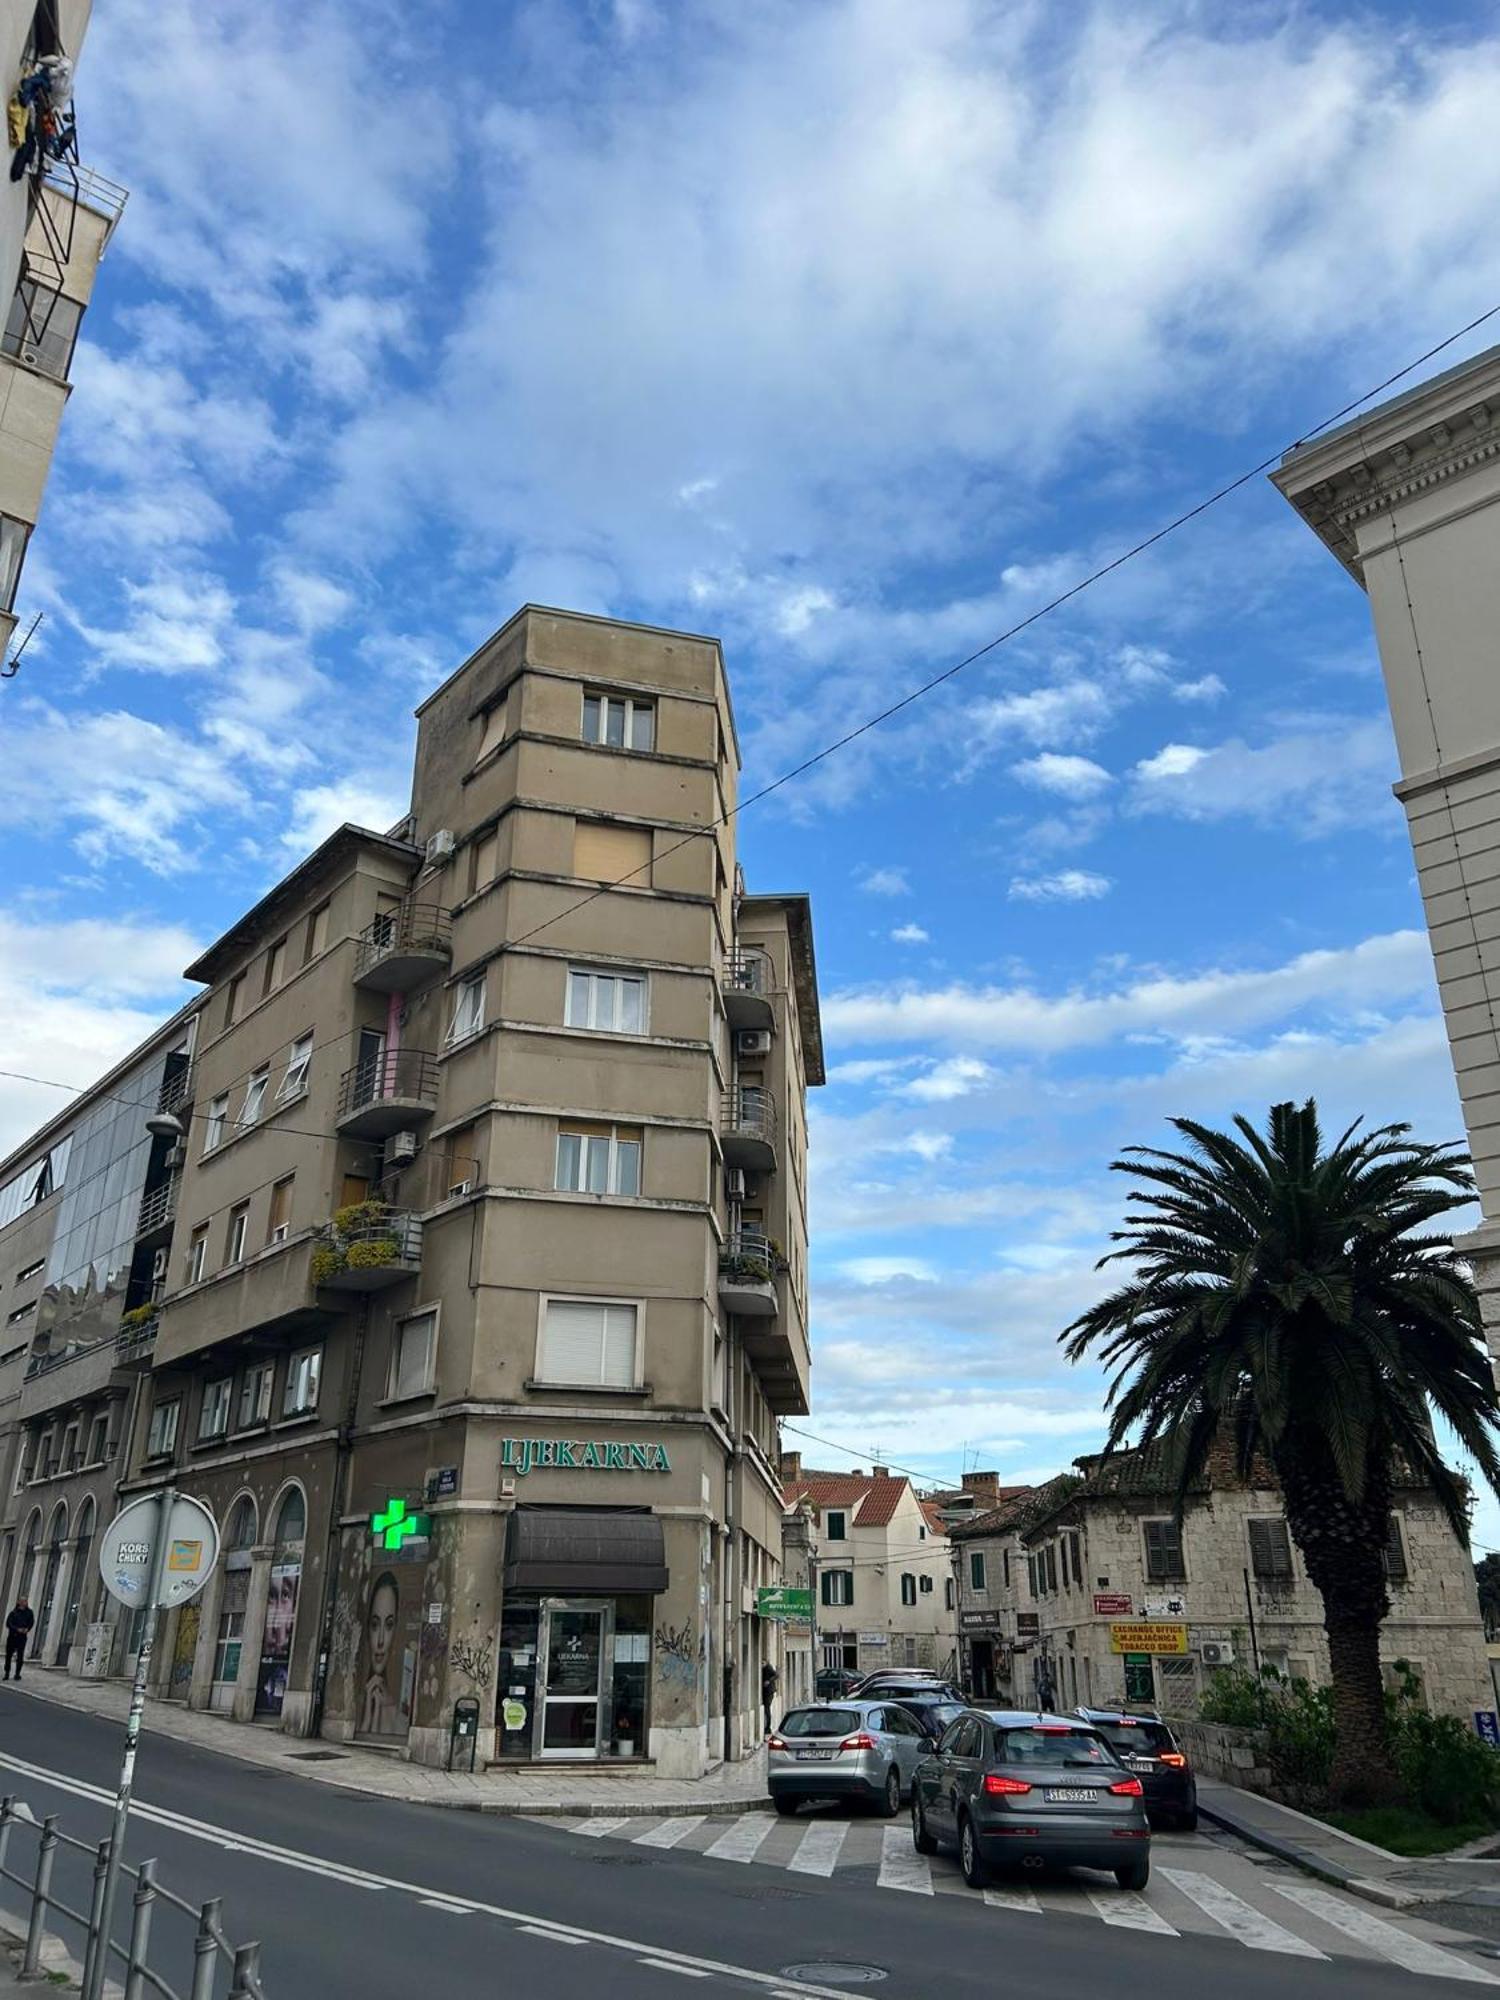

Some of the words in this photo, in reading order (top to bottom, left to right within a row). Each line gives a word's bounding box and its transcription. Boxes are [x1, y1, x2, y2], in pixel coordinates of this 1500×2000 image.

[501, 1438, 672, 1475] LJEKARNA
[119, 1543, 149, 1553] KORS
[1113, 1625, 1153, 1633] EXCHANGE
[1156, 1625, 1183, 1633] OFFICE
[1158, 1643, 1179, 1651] SHOP
